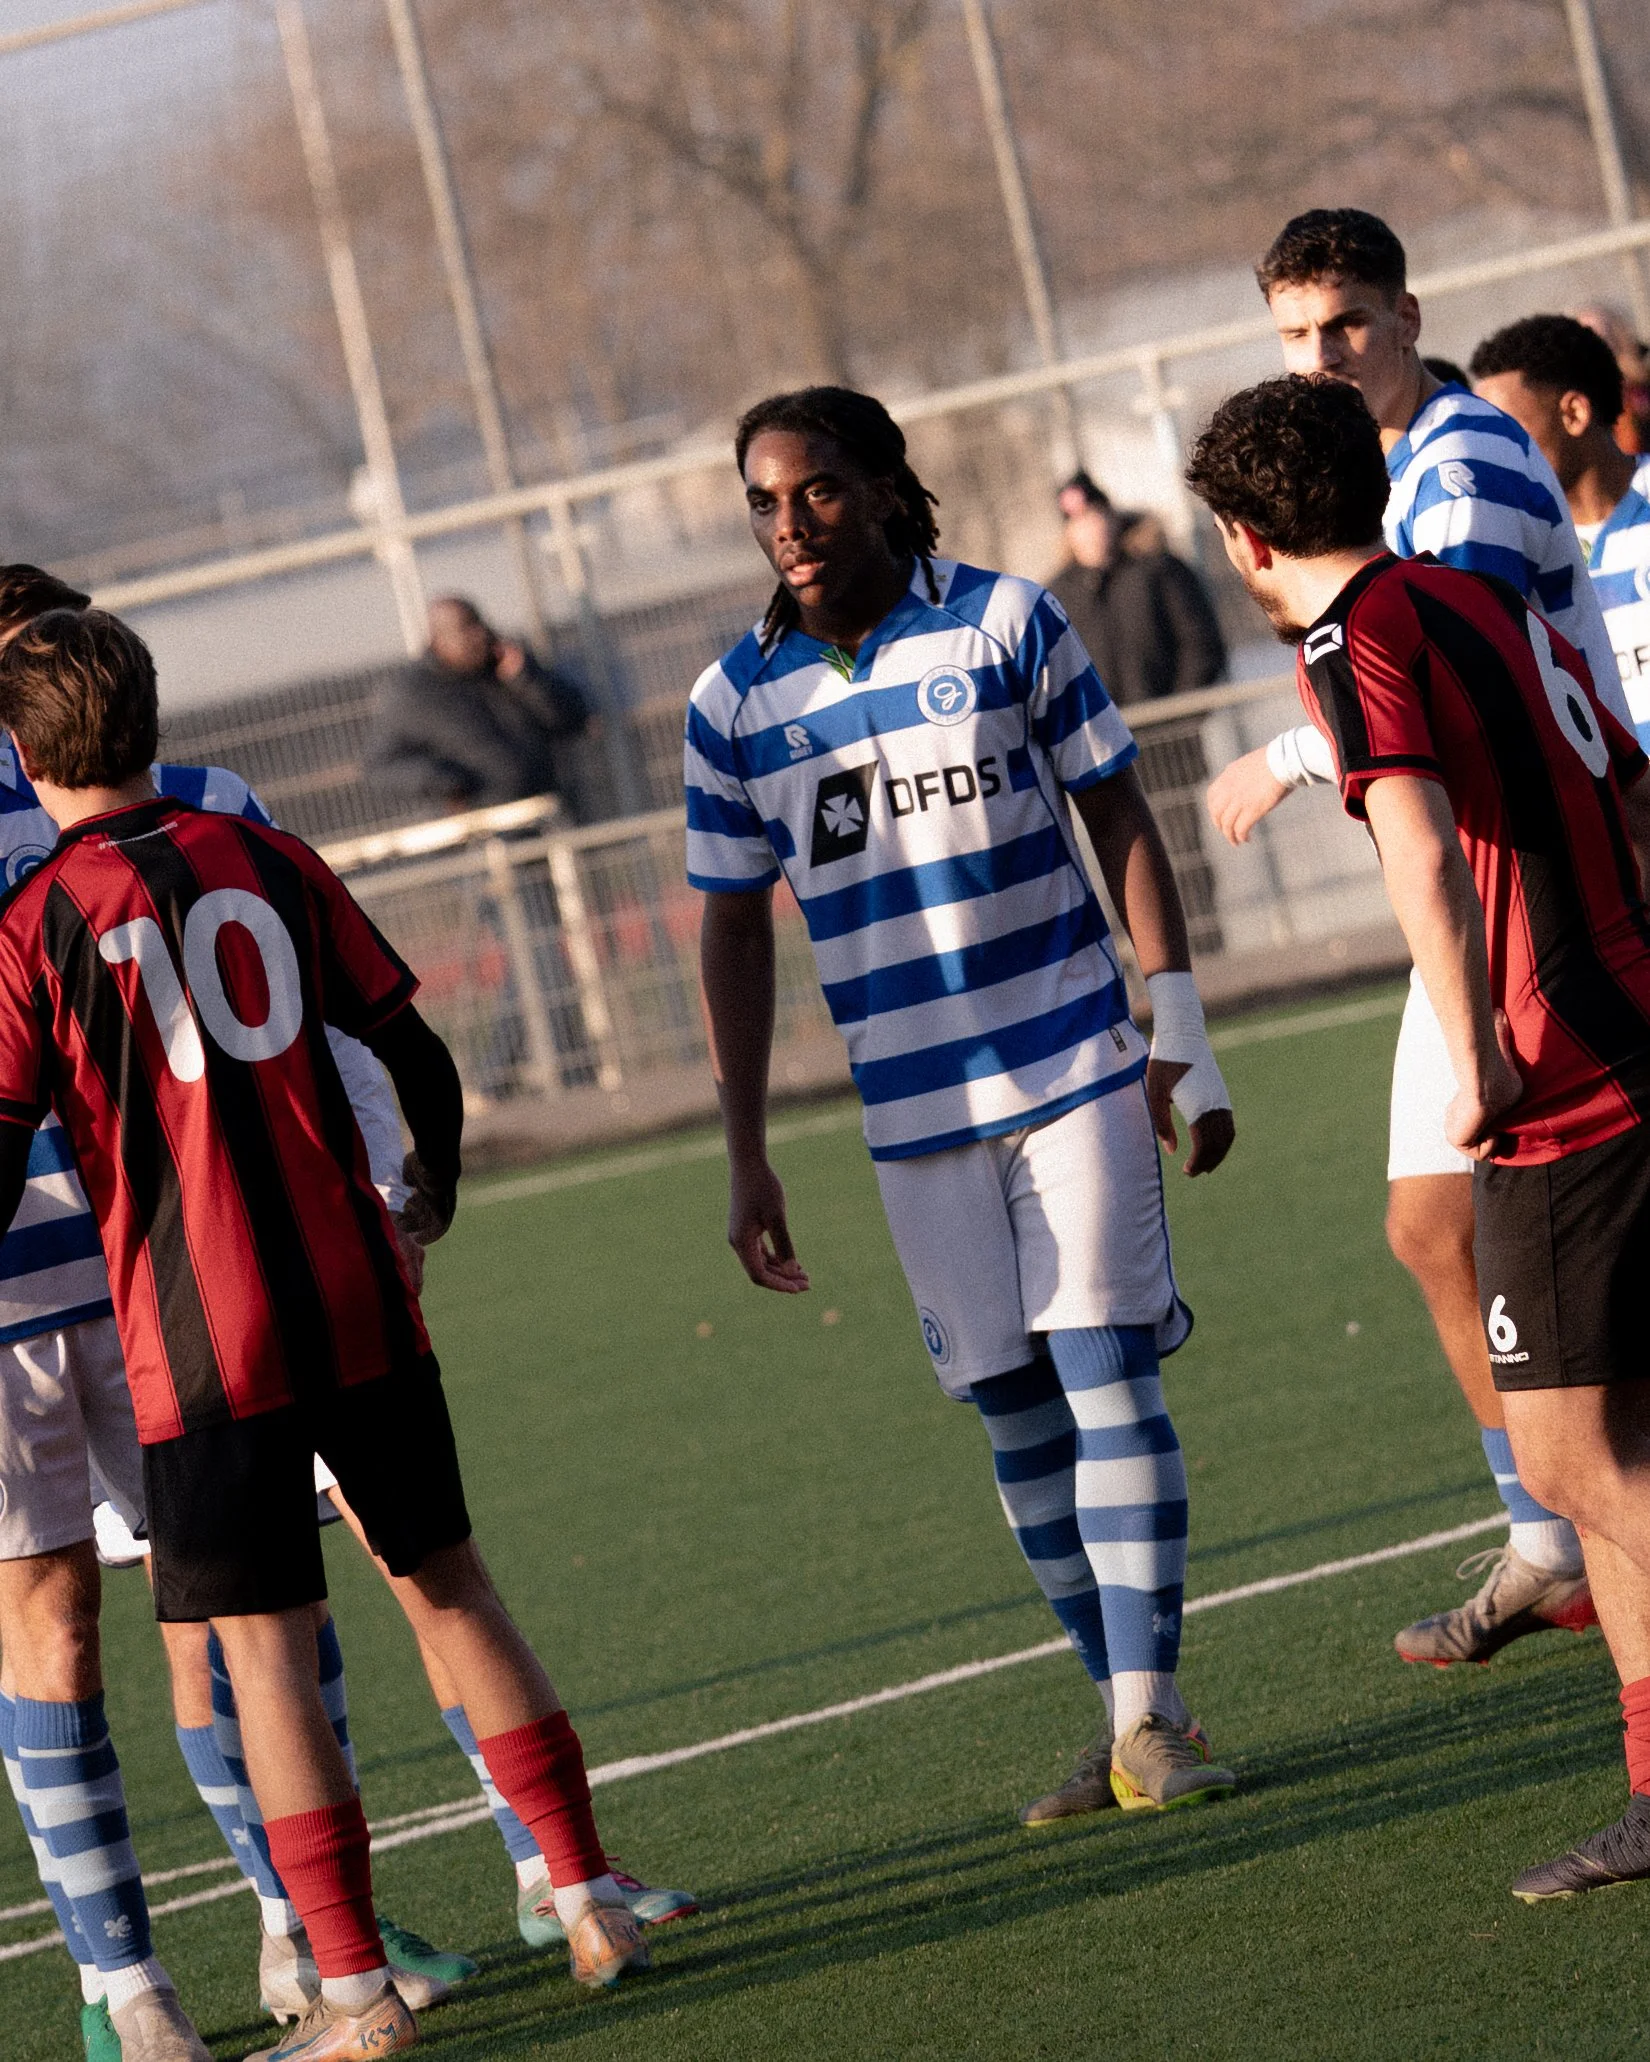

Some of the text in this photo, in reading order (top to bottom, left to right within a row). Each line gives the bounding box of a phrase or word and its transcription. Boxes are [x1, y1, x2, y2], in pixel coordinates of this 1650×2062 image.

[1526, 607, 1610, 779] 6
[885, 756, 1001, 819] DFDS
[99, 887, 304, 1084] 10
[1488, 1294, 1518, 1353] 6
